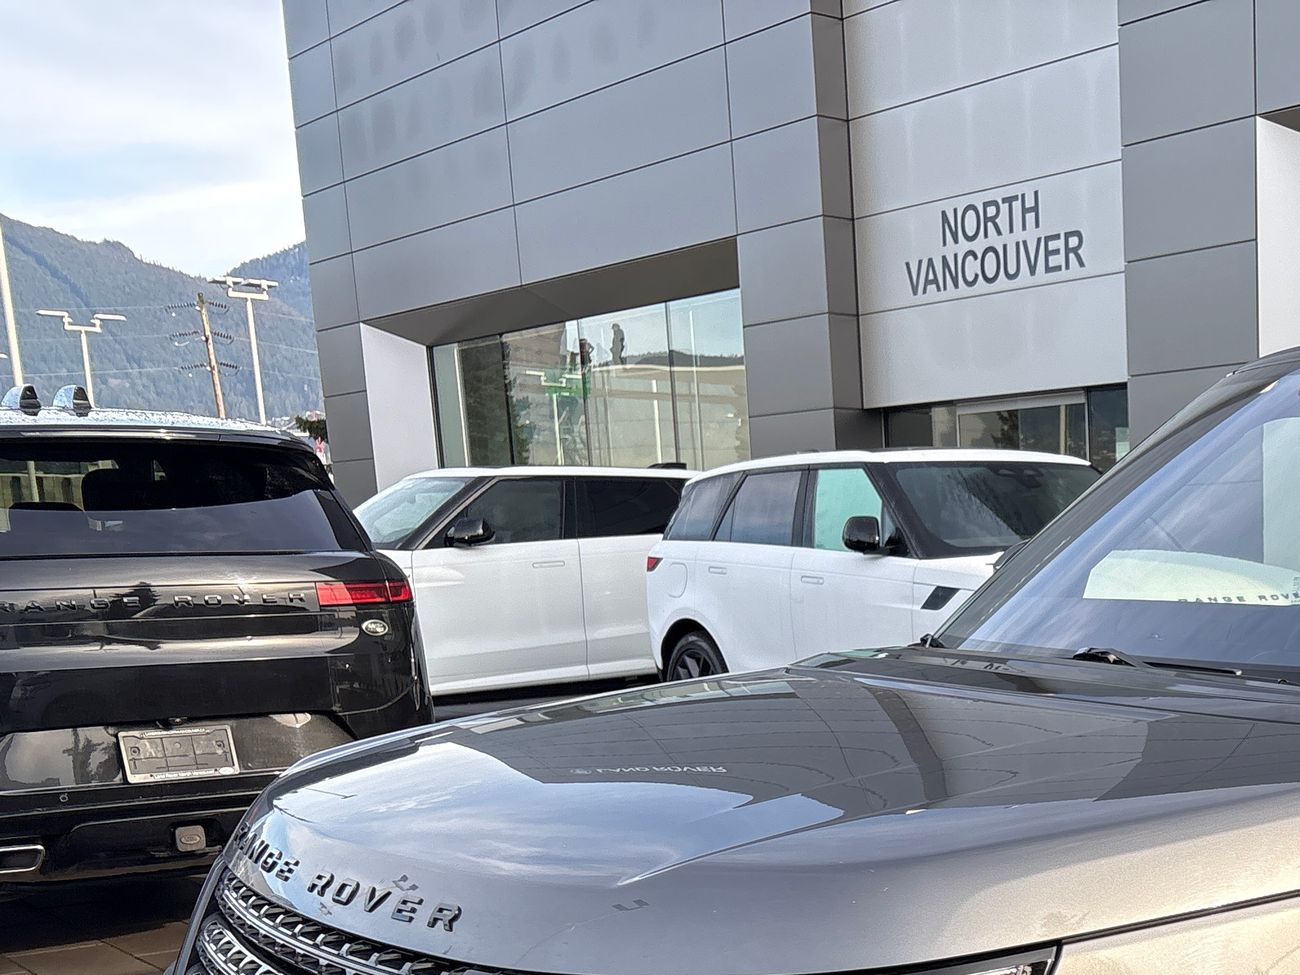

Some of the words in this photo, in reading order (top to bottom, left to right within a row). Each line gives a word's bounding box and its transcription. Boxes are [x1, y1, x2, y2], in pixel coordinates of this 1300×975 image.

[941, 190, 1040, 247] NORTH
[905, 230, 1085, 296] VANCOUVER
[173, 592, 307, 611] ROVER
[307, 871, 463, 933] ROVER
